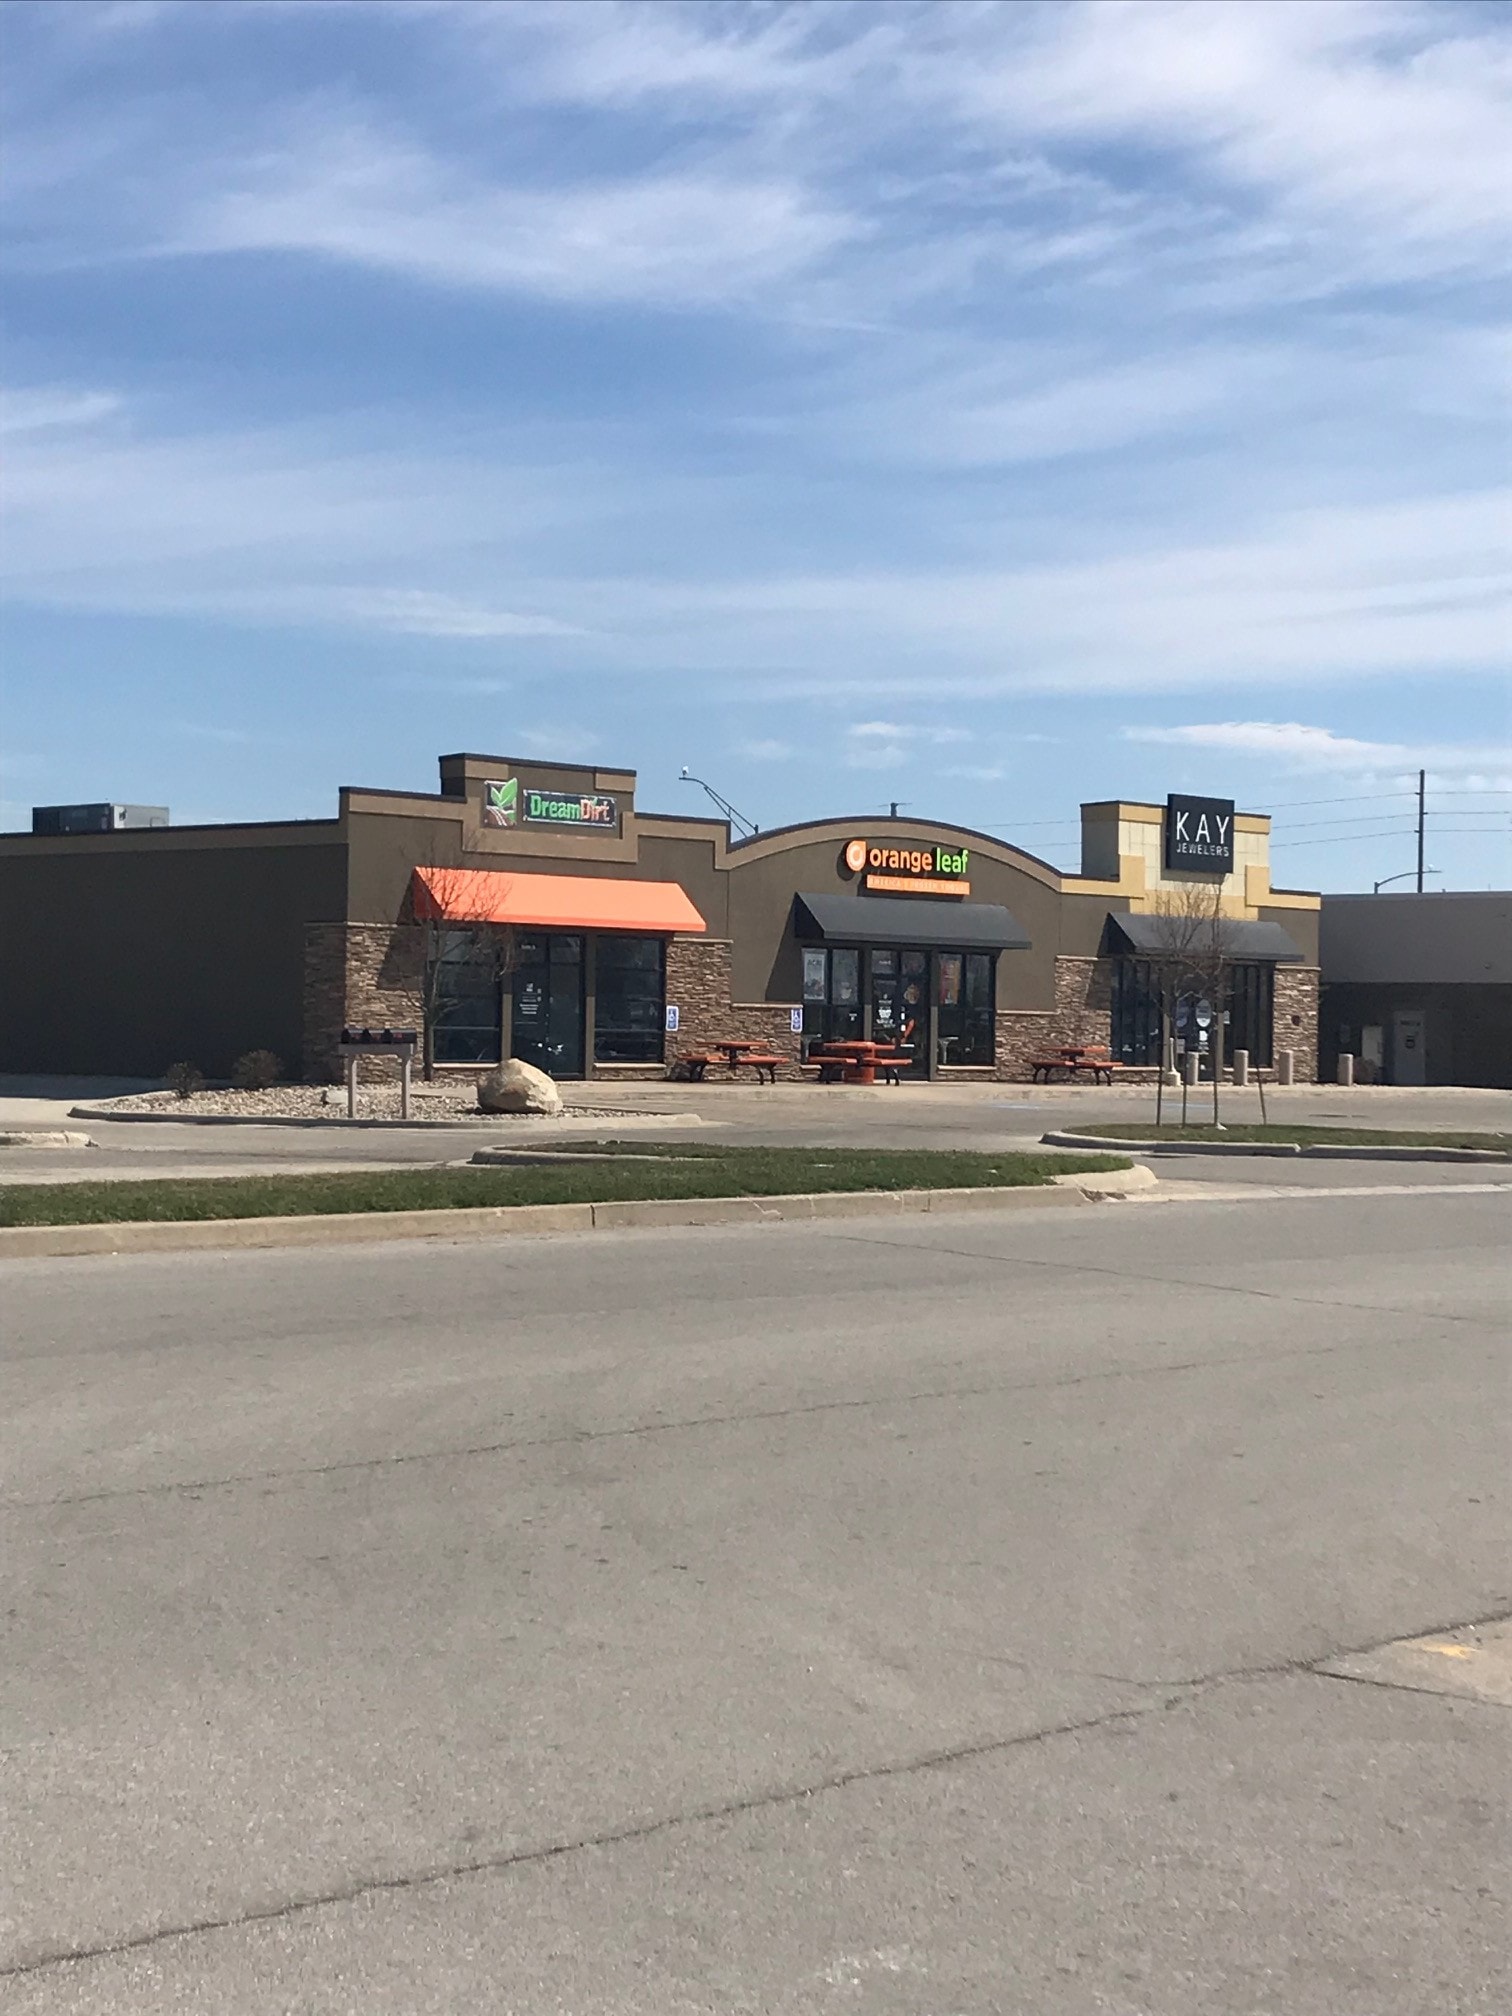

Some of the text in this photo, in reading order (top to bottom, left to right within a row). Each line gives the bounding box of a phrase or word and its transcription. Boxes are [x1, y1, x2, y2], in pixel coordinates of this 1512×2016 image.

[530, 795, 610, 821] DreamDirt
[1176, 811, 1229, 844] KAY
[869, 847, 969, 873] orange leaf
[1176, 842, 1230, 857] JEWELERS
